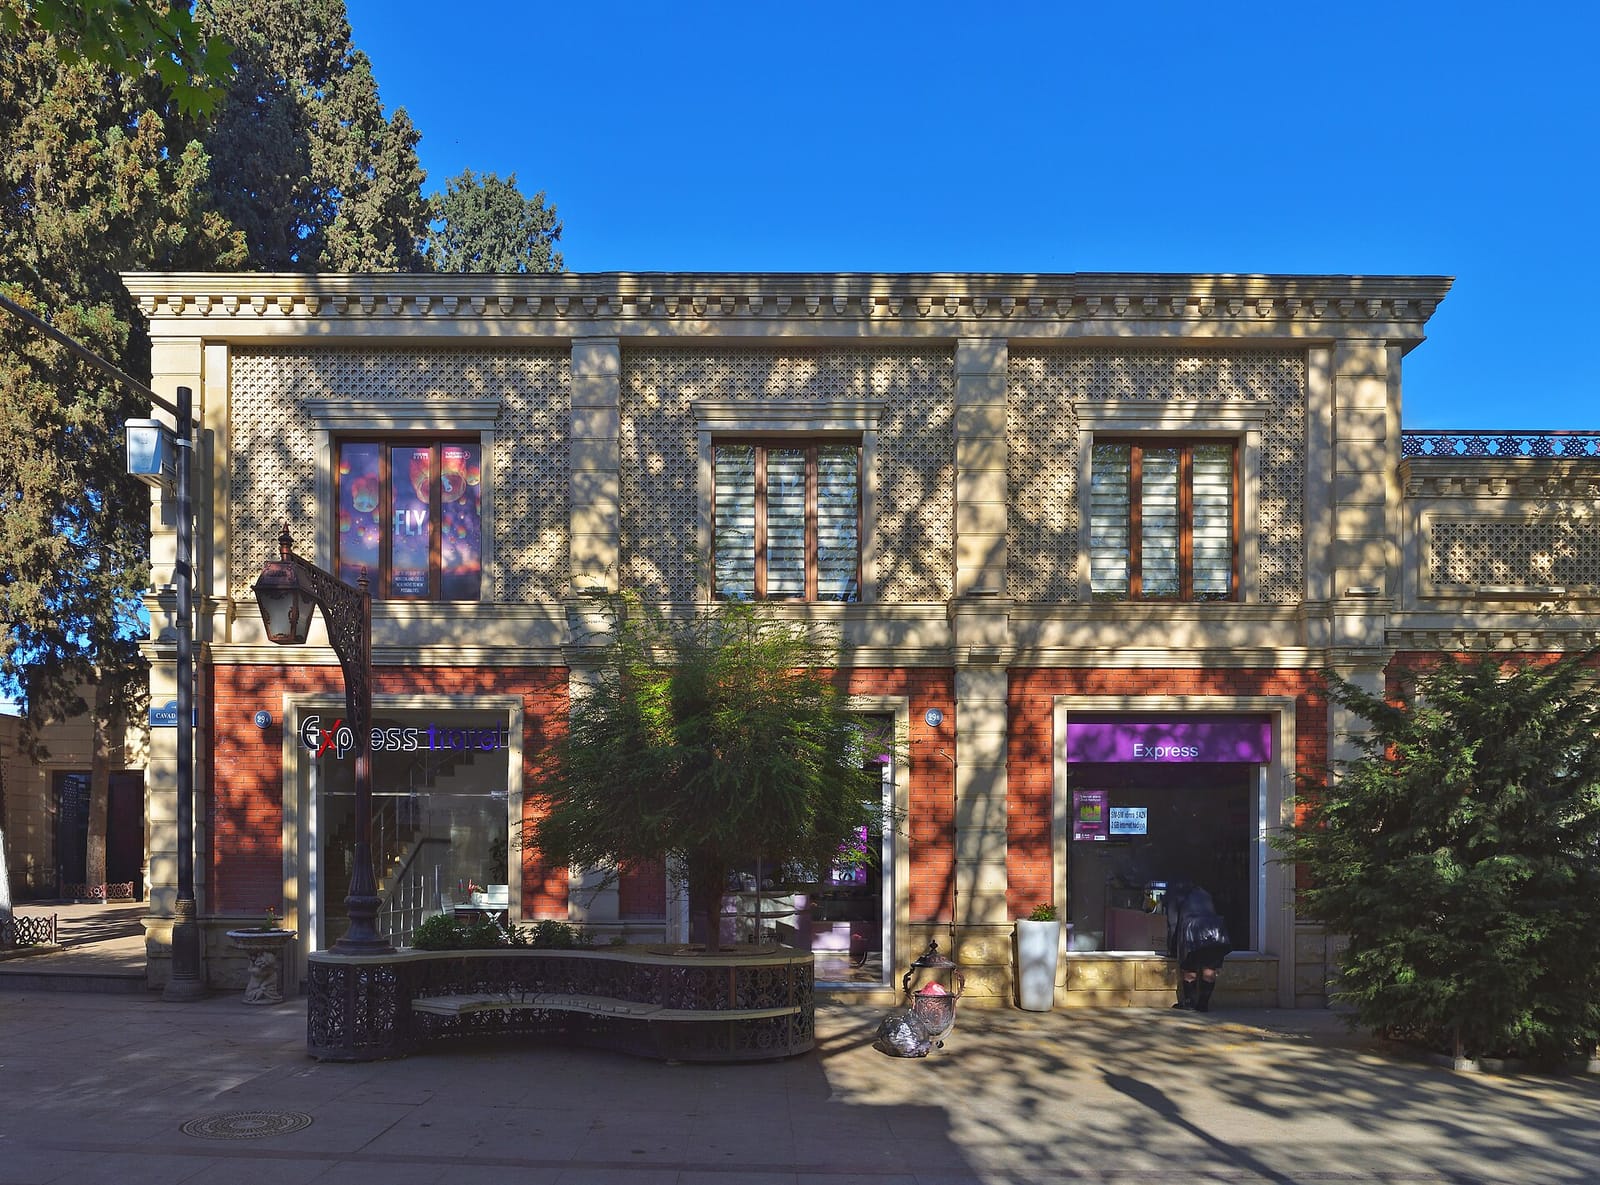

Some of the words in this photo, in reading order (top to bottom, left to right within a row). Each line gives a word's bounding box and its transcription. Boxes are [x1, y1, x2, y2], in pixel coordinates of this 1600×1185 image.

[395, 510, 427, 536] FLY
[301, 715, 418, 759] Expess
[427, 720, 502, 752] travel
[1133, 743, 1199, 760] Express
